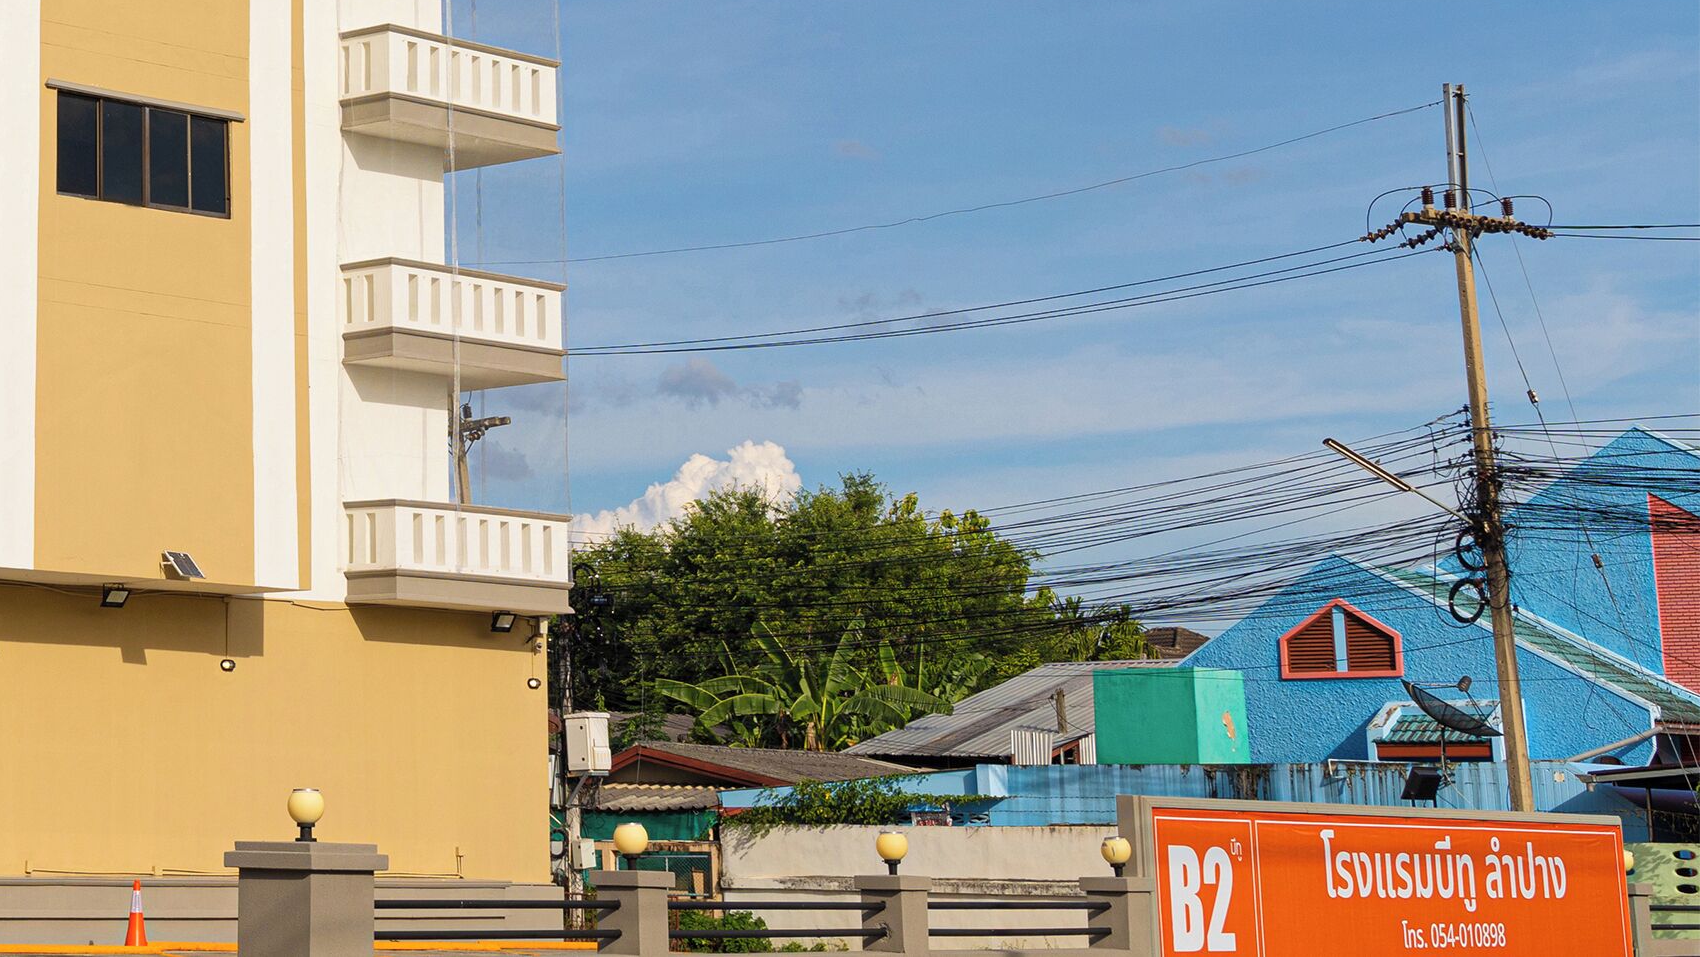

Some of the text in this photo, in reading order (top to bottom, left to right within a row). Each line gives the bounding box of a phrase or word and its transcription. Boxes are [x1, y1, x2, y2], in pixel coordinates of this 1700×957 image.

[1230, 837, 1243, 862] บีทู
[1320, 829, 1567, 912] โรงแรมบีทู ลำปาง
[1167, 844, 1237, 953] B2
[1401, 920, 1507, 949] โทร. 054-010898
